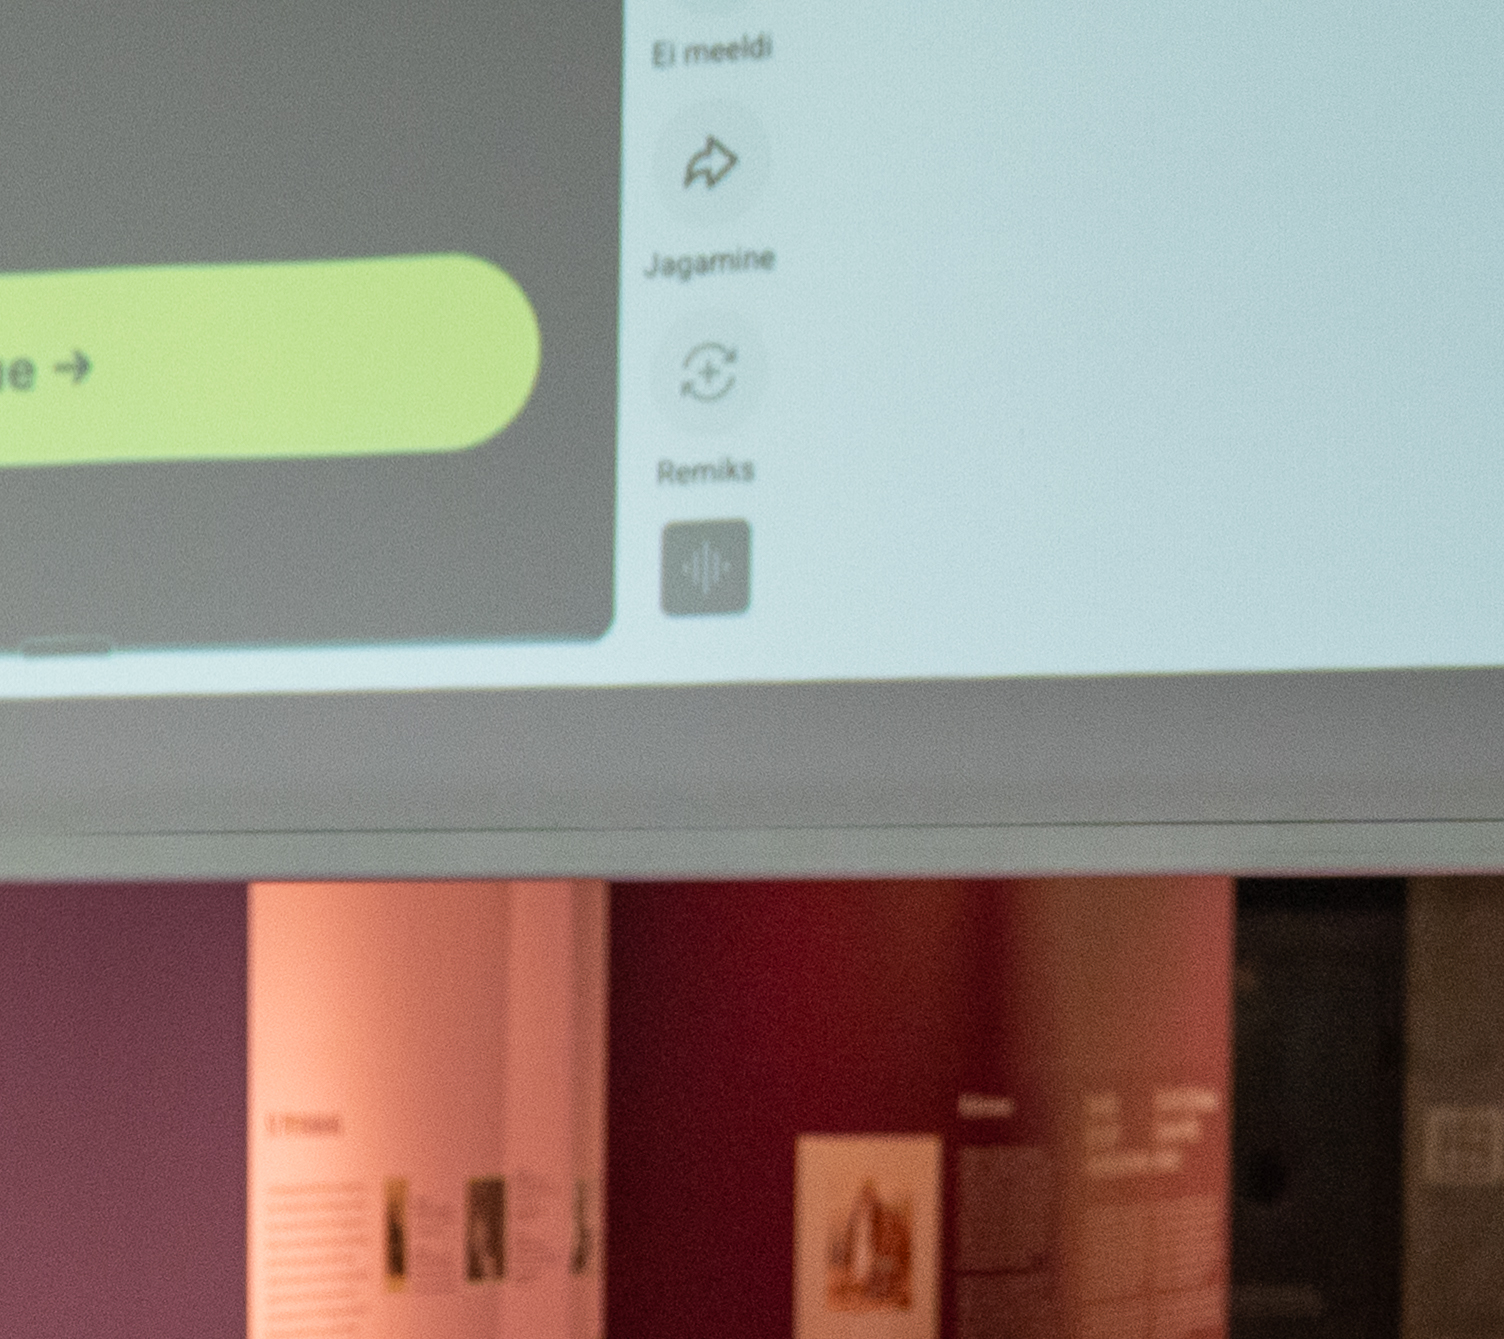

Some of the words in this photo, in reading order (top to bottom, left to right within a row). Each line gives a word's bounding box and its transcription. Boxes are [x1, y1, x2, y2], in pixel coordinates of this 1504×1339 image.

[652, 39, 675, 69] Ei
[684, 32, 772, 64] meeldi
[644, 246, 776, 281] Jagamine
[657, 457, 755, 486] Remiks
